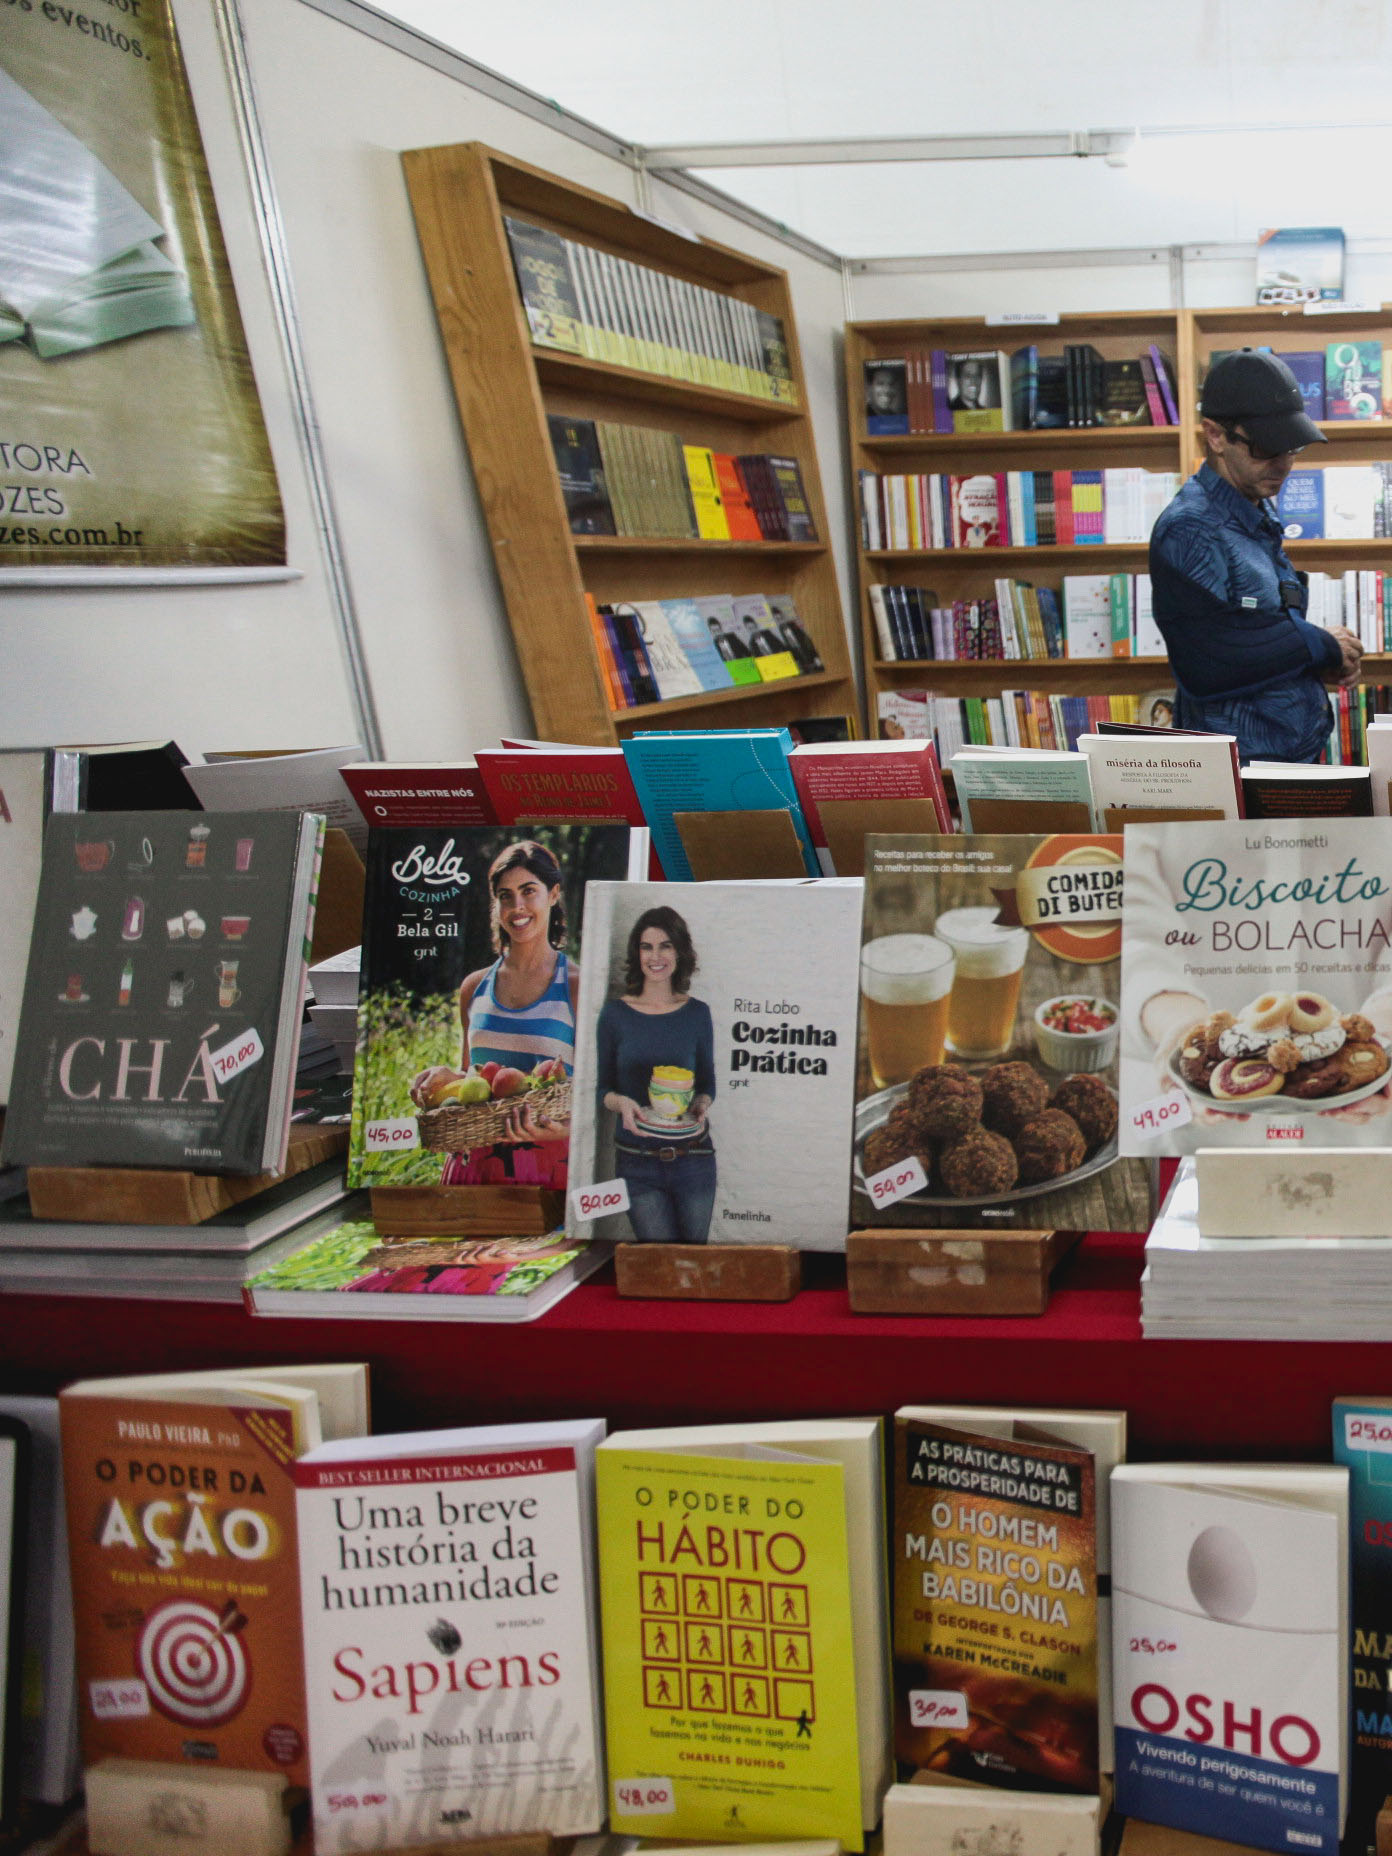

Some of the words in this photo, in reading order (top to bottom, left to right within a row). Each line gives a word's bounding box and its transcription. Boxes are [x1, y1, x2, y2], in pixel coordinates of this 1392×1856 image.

[42, 1, 151, 61] eventos.
[1106, 758, 1143, 768] miséria
[1146, 759, 1158, 768] da
[1160, 758, 1202, 768] filosofia
[365, 789, 415, 798] NAZISTAS
[417, 789, 449, 798] ENTRE
[451, 788, 474, 797] NÓS
[502, 774, 521, 792] OS
[524, 770, 618, 792] TEMPLÁRIOS
[874, 850, 904, 860] Receitas
[906, 852, 923, 861] para
[925, 850, 953, 860] receber
[955, 852, 964, 860] os
[966, 850, 994, 861] amigos
[1245, 837, 1260, 849] Lu
[1265, 835, 1328, 849] Bonometti
[392, 838, 470, 886] Bela
[399, 885, 460, 903] COZINHA
[1047, 870, 1124, 894] COMIDA
[1175, 857, 1389, 912] Biscoito
[423, 908, 434, 921] 2
[1037, 896, 1061, 918] DI
[1068, 891, 1123, 913] BUTE
[397, 924, 430, 938] Bela
[435, 923, 459, 938] Gil
[1165, 928, 1203, 946] ou
[1184, 964, 1232, 977] Pequenas
[1235, 963, 1273, 975] delícias
[1275, 965, 1291, 974] em
[1294, 962, 1308, 973] 50
[1311, 962, 1352, 973] receitas
[1355, 963, 1362, 972] e
[1364, 961, 1391, 973] dicas
[734, 999, 760, 1014] Rita
[765, 1000, 800, 1015] Lobo
[732, 1020, 837, 1047] Cozinha
[59, 1024, 225, 1103] CHÁ
[214, 1041, 257, 1076] 70,00
[731, 1050, 828, 1076] Prática
[1134, 1101, 1181, 1130] 49,00
[368, 1127, 413, 1144] 45,00
[722, 1209, 771, 1223] Panelinha
[118, 1420, 161, 1441] PAULO
[96, 1459, 117, 1482] O
[129, 1462, 218, 1491] PODER
[231, 1470, 267, 1495] DA
[318, 1466, 412, 1486] BEST-SELLER
[416, 1458, 547, 1479] INTERNACIONAL
[332, 1496, 424, 1532] Uma
[437, 1491, 539, 1525] breve
[636, 1487, 653, 1506] O
[668, 1489, 750, 1515] PODER
[767, 1499, 803, 1519] DO
[101, 1493, 270, 1568] AÇÃO
[931, 1502, 952, 1528] O
[959, 1507, 1059, 1552] HOMEM
[338, 1531, 478, 1570] história
[492, 1526, 538, 1561] da
[636, 1512, 807, 1575] HÁBITO
[905, 1533, 971, 1569] MAIS
[977, 1546, 1040, 1584] RICO
[1048, 1564, 1086, 1596] DA
[321, 1562, 560, 1611] humanidade
[922, 1571, 1071, 1628] BABILÔNIA
[1129, 1637, 1178, 1654] 25,00
[332, 1646, 561, 1714] Sapiens
[1354, 1668, 1382, 1691] DA
[1130, 1682, 1321, 1767] OSHO
[366, 1731, 416, 1753] Yuval
[422, 1730, 472, 1748] Noah
[478, 1726, 535, 1745] Harari
[679, 1751, 731, 1765] CHARLES
[736, 1757, 786, 1770] DUHIGG
[619, 1787, 668, 1809] 48,00
